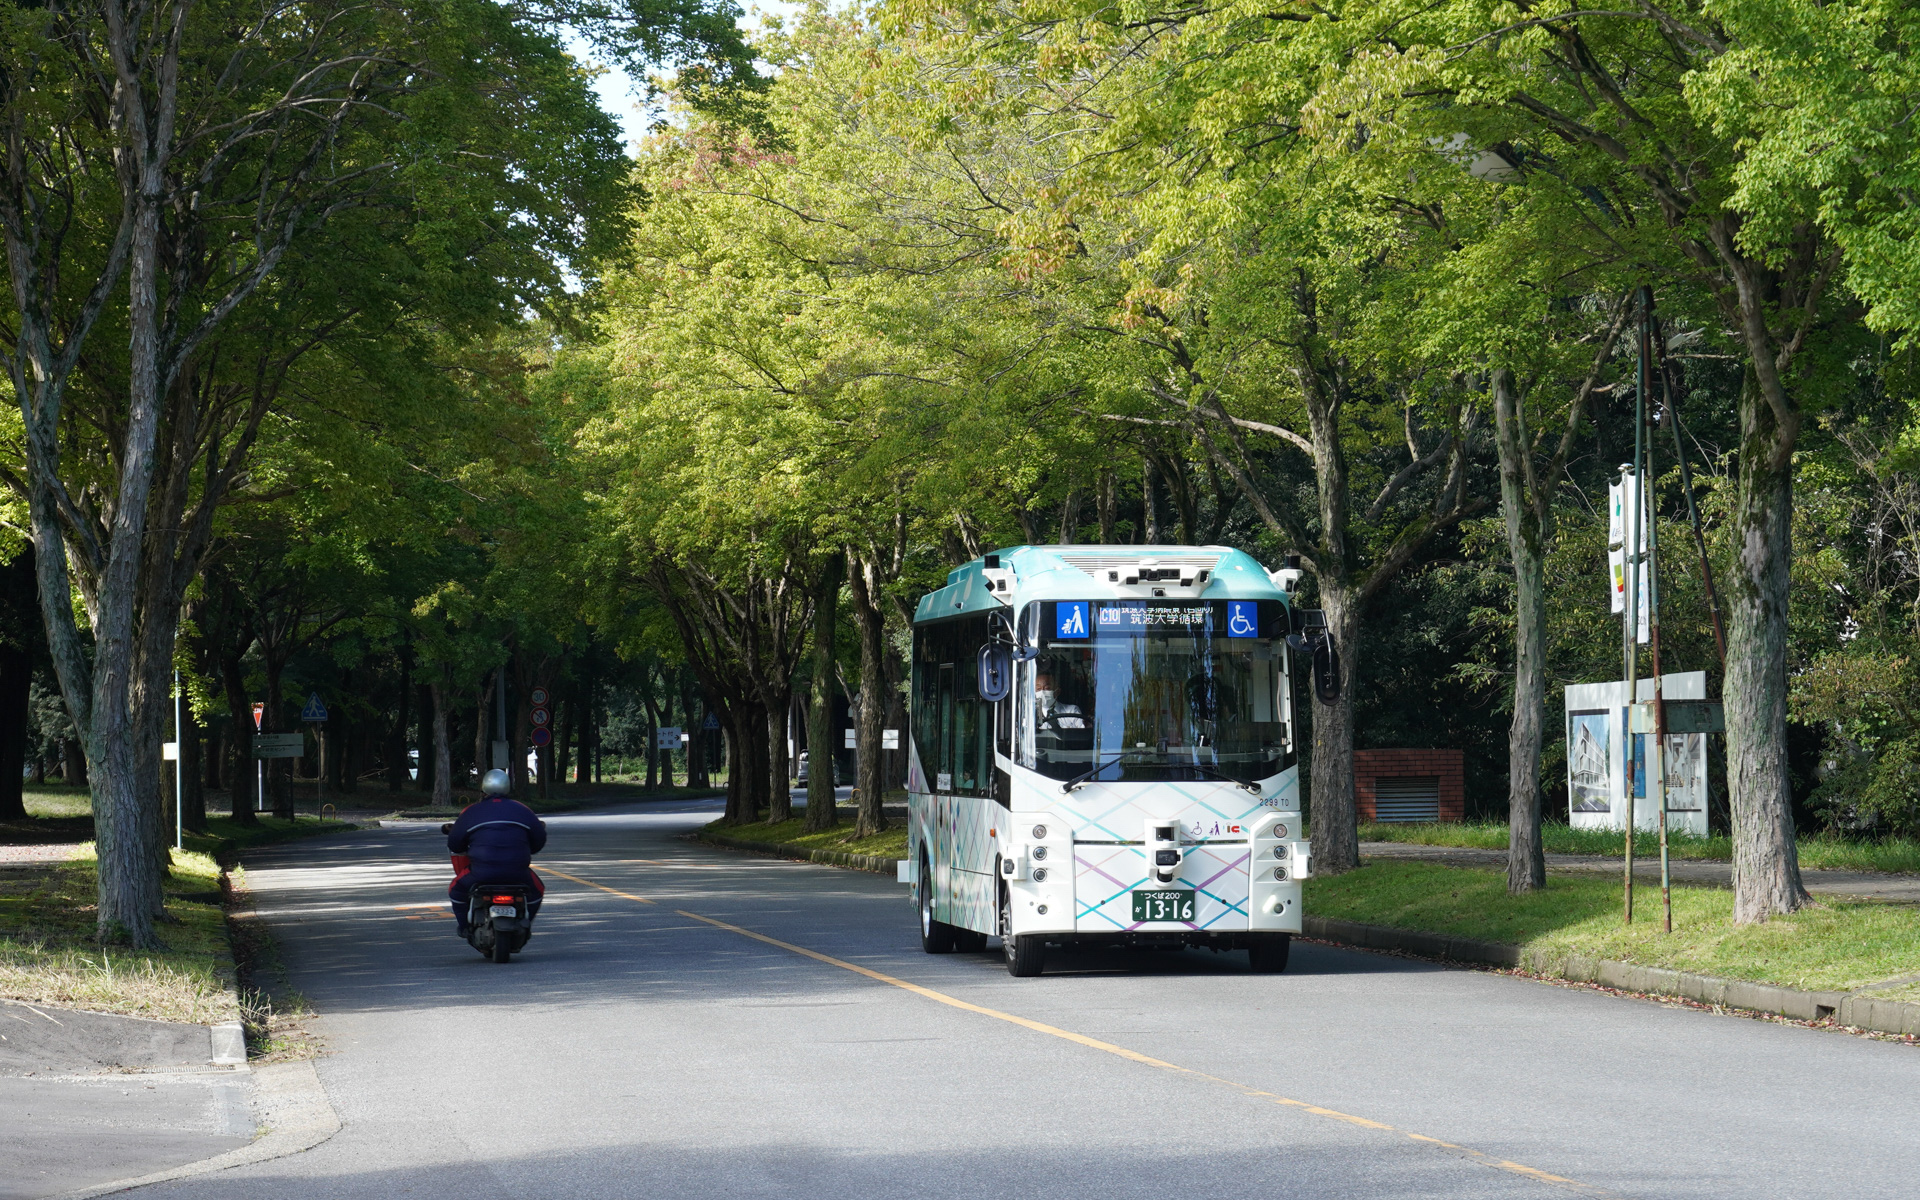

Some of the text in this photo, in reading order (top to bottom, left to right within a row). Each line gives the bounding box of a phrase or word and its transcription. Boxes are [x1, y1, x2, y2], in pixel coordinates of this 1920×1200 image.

[1101, 608, 1119, 622] C10
[1130, 613, 1203, 625] 筑波大学循環
[534, 692, 545, 702] 30
[1259, 798, 1279, 807] 2299
[1144, 892, 1181, 900] つくば200
[1145, 900, 1192, 919] 13-16
